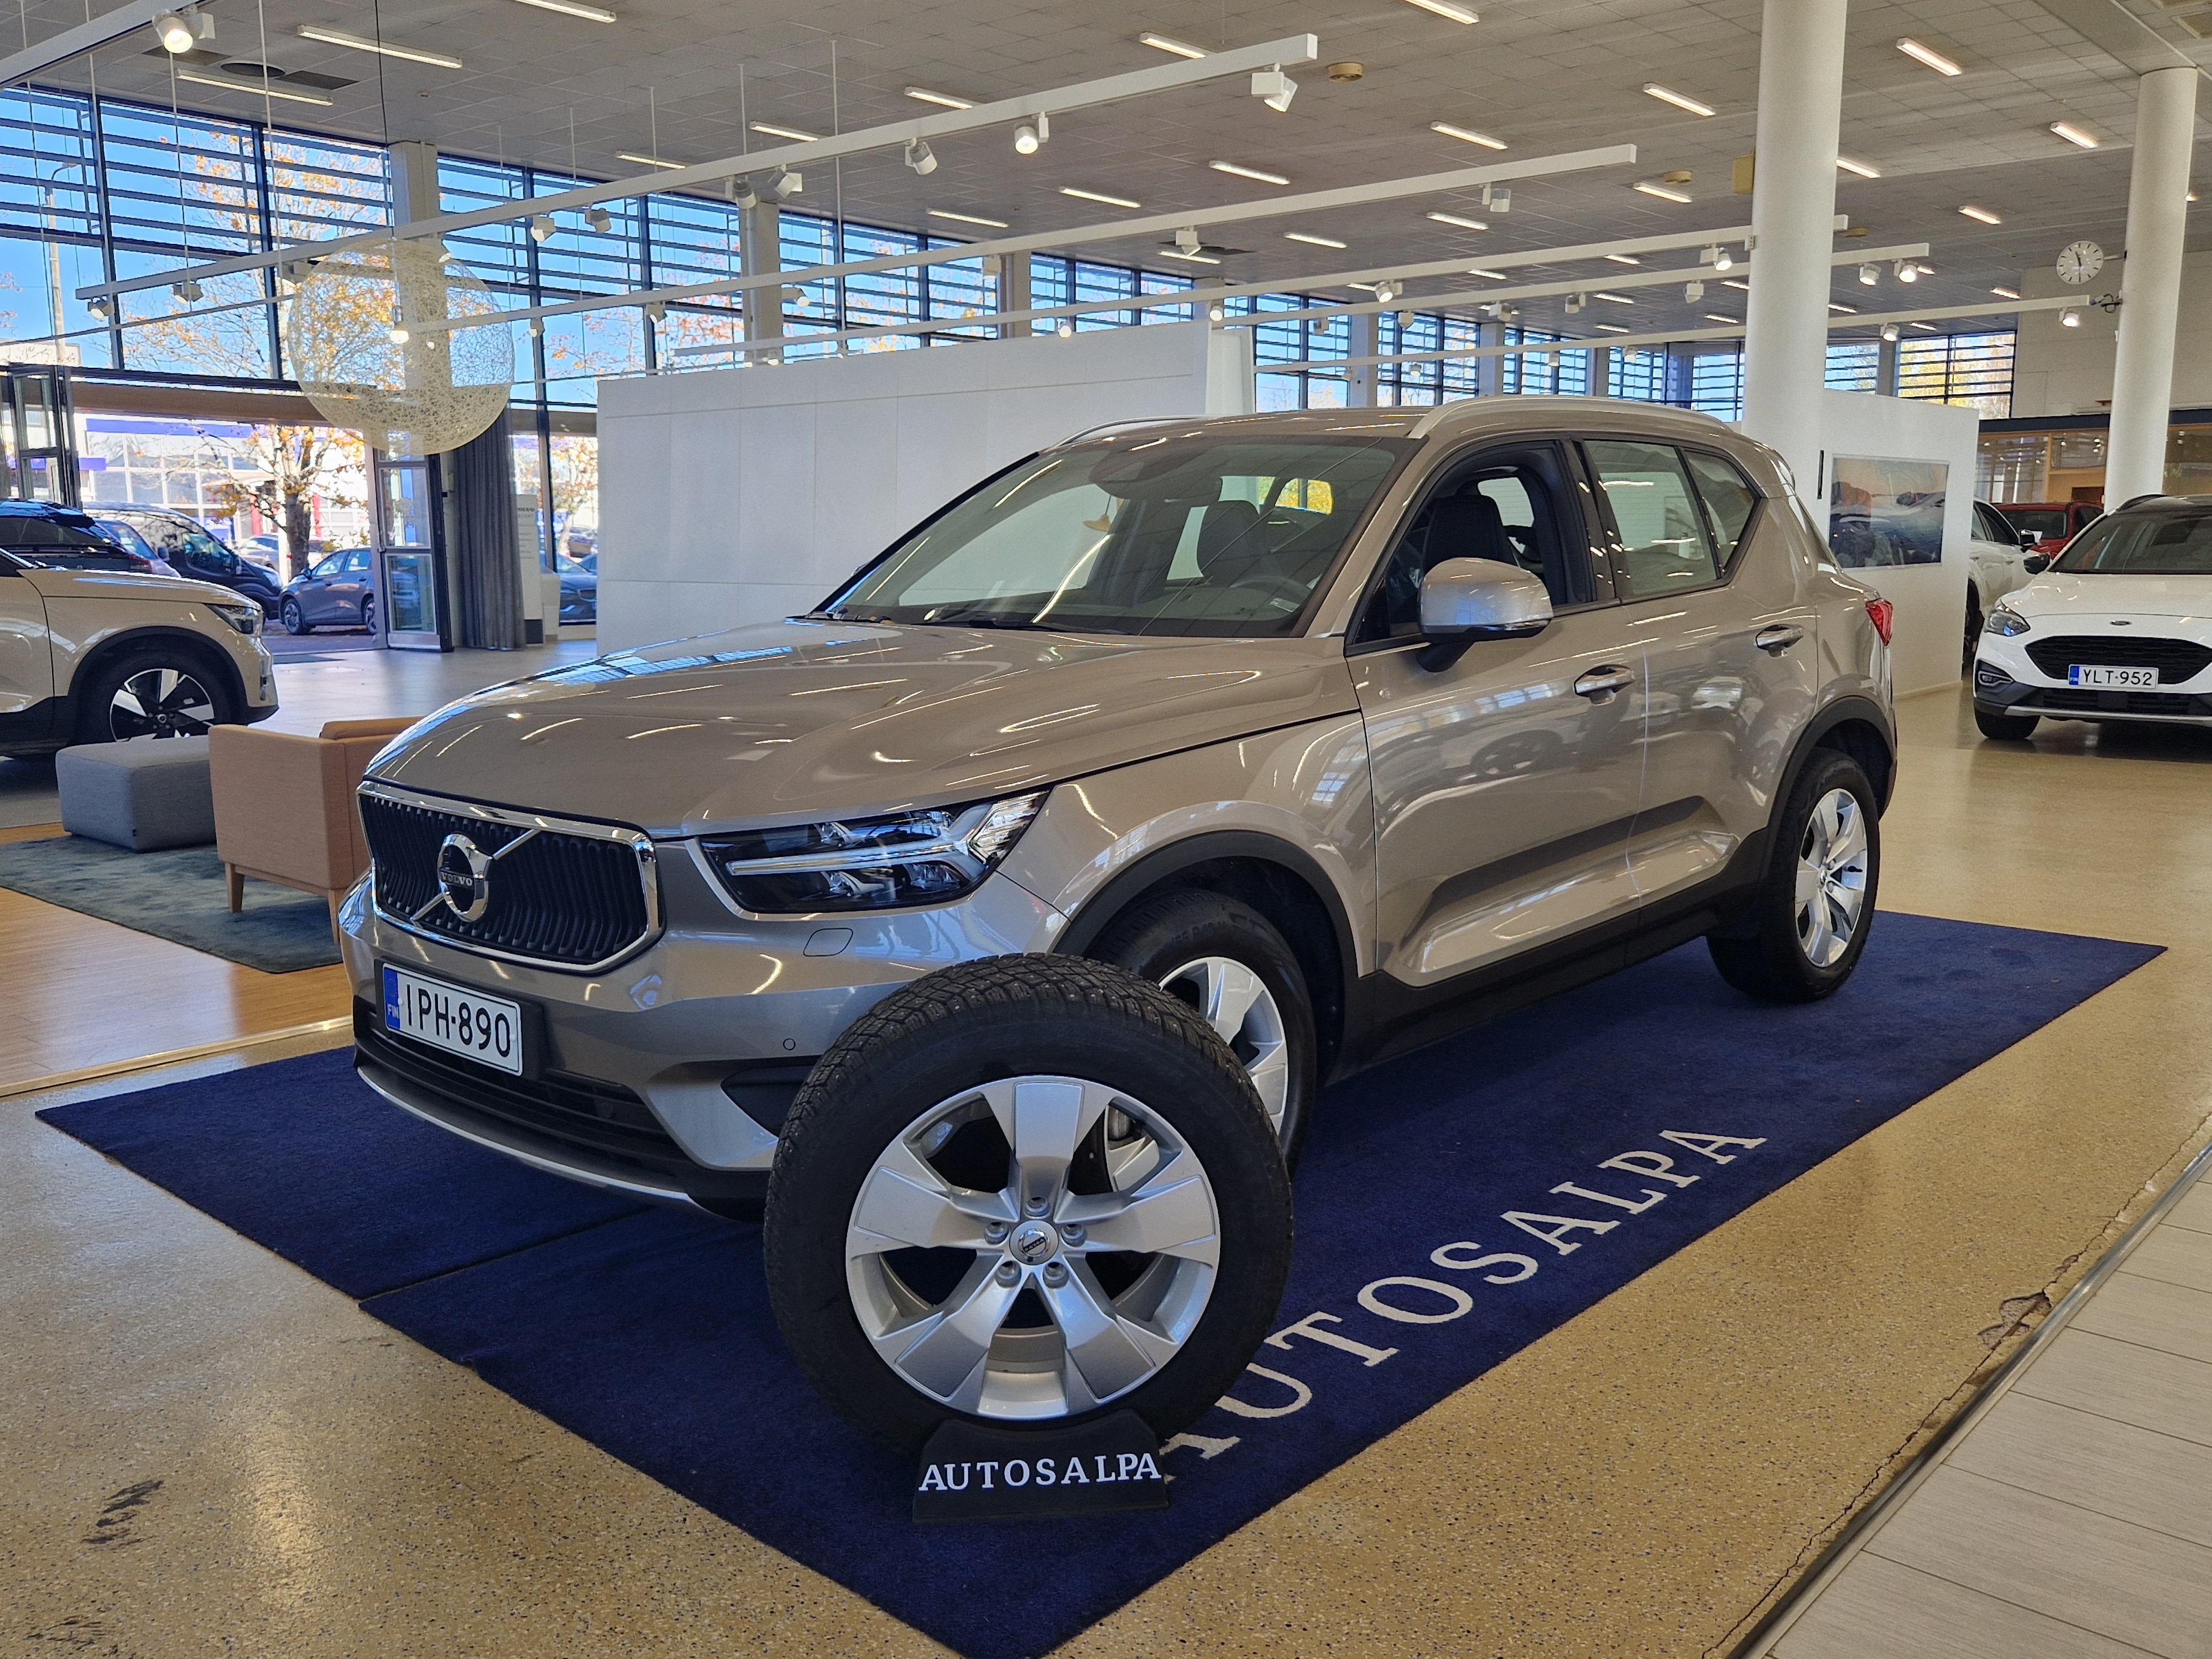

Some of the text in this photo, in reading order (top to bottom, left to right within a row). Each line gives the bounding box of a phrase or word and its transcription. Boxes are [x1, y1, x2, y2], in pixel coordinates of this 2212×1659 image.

[2083, 669, 2152, 686] YLT-952
[441, 872, 473, 886] VOLVO
[387, 1003, 399, 1019] FIN
[406, 984, 511, 1057] IPH-890
[918, 1453, 1162, 1491] AUTOSALPA
